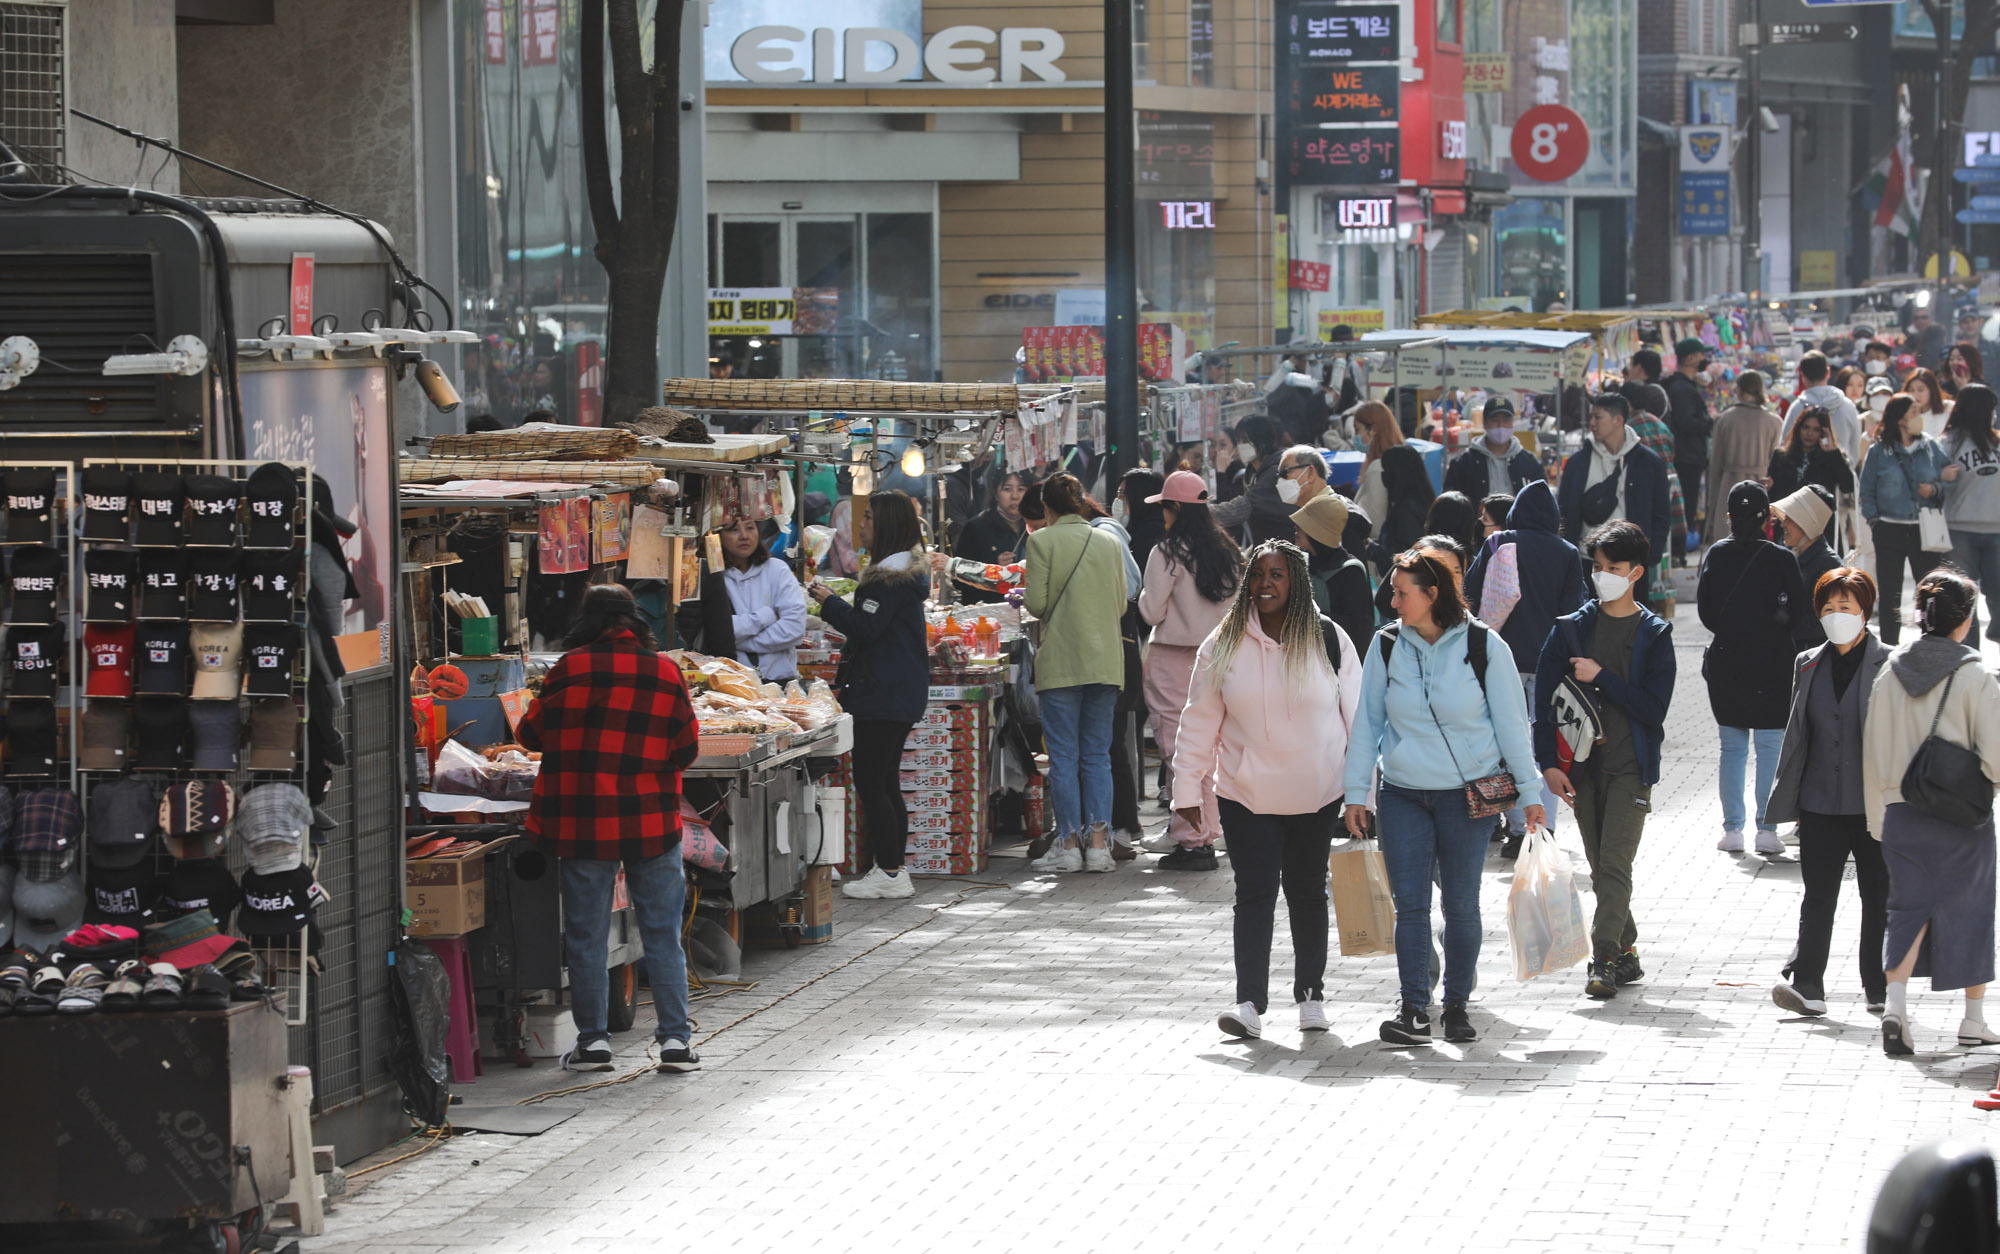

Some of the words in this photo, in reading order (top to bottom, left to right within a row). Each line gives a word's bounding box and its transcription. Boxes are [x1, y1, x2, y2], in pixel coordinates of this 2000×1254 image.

[1307, 16, 1390, 37] 보드게임
[730, 25, 1067, 84] EIDER
[1308, 48, 1352, 56] MONACO
[1332, 72, 1363, 89] WE
[1313, 93, 1382, 110] 시계거래소
[1305, 138, 1395, 164] 약손명가
[1380, 169, 1393, 179] 5F
[1339, 199, 1393, 227] USDT
[8, 495, 46, 510] 꽃미남
[141, 499, 173, 515] 대박
[253, 501, 283, 516] 대장
[147, 573, 178, 588] 최고
[92, 643, 123, 654] KOREA
[145, 640, 176, 650] KOREA
[198, 645, 229, 654] KOREA
[253, 646, 284, 656] KOREA
[247, 895, 295, 911] KOREA
[417, 893, 426, 906] 5
